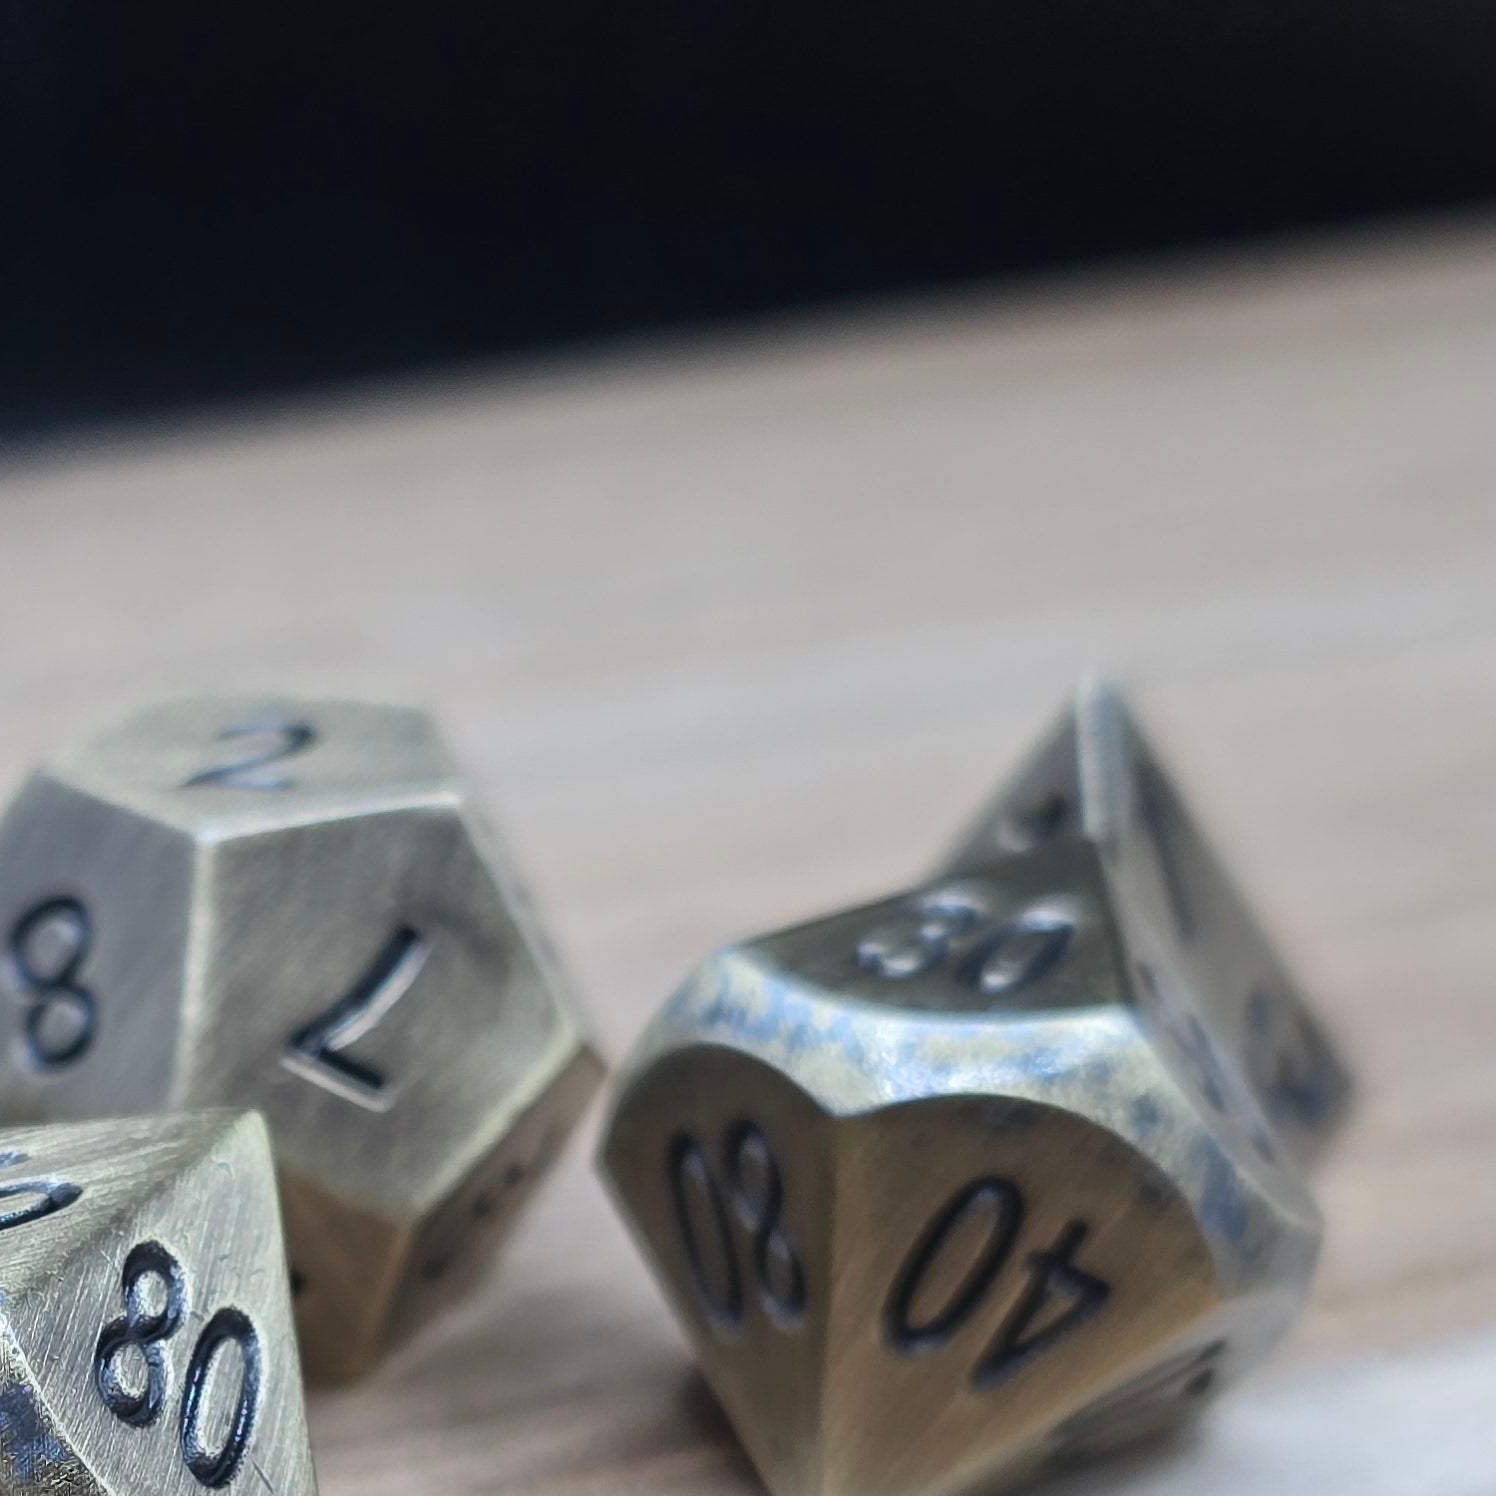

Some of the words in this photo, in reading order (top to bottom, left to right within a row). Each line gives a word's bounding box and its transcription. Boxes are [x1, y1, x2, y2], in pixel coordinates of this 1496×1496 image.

[182, 719, 318, 791] 2
[4, 893, 96, 1074] 8
[276, 925, 426, 1112] 7
[92, 1238, 264, 1490] 80
[882, 1174, 1110, 1390] 40
